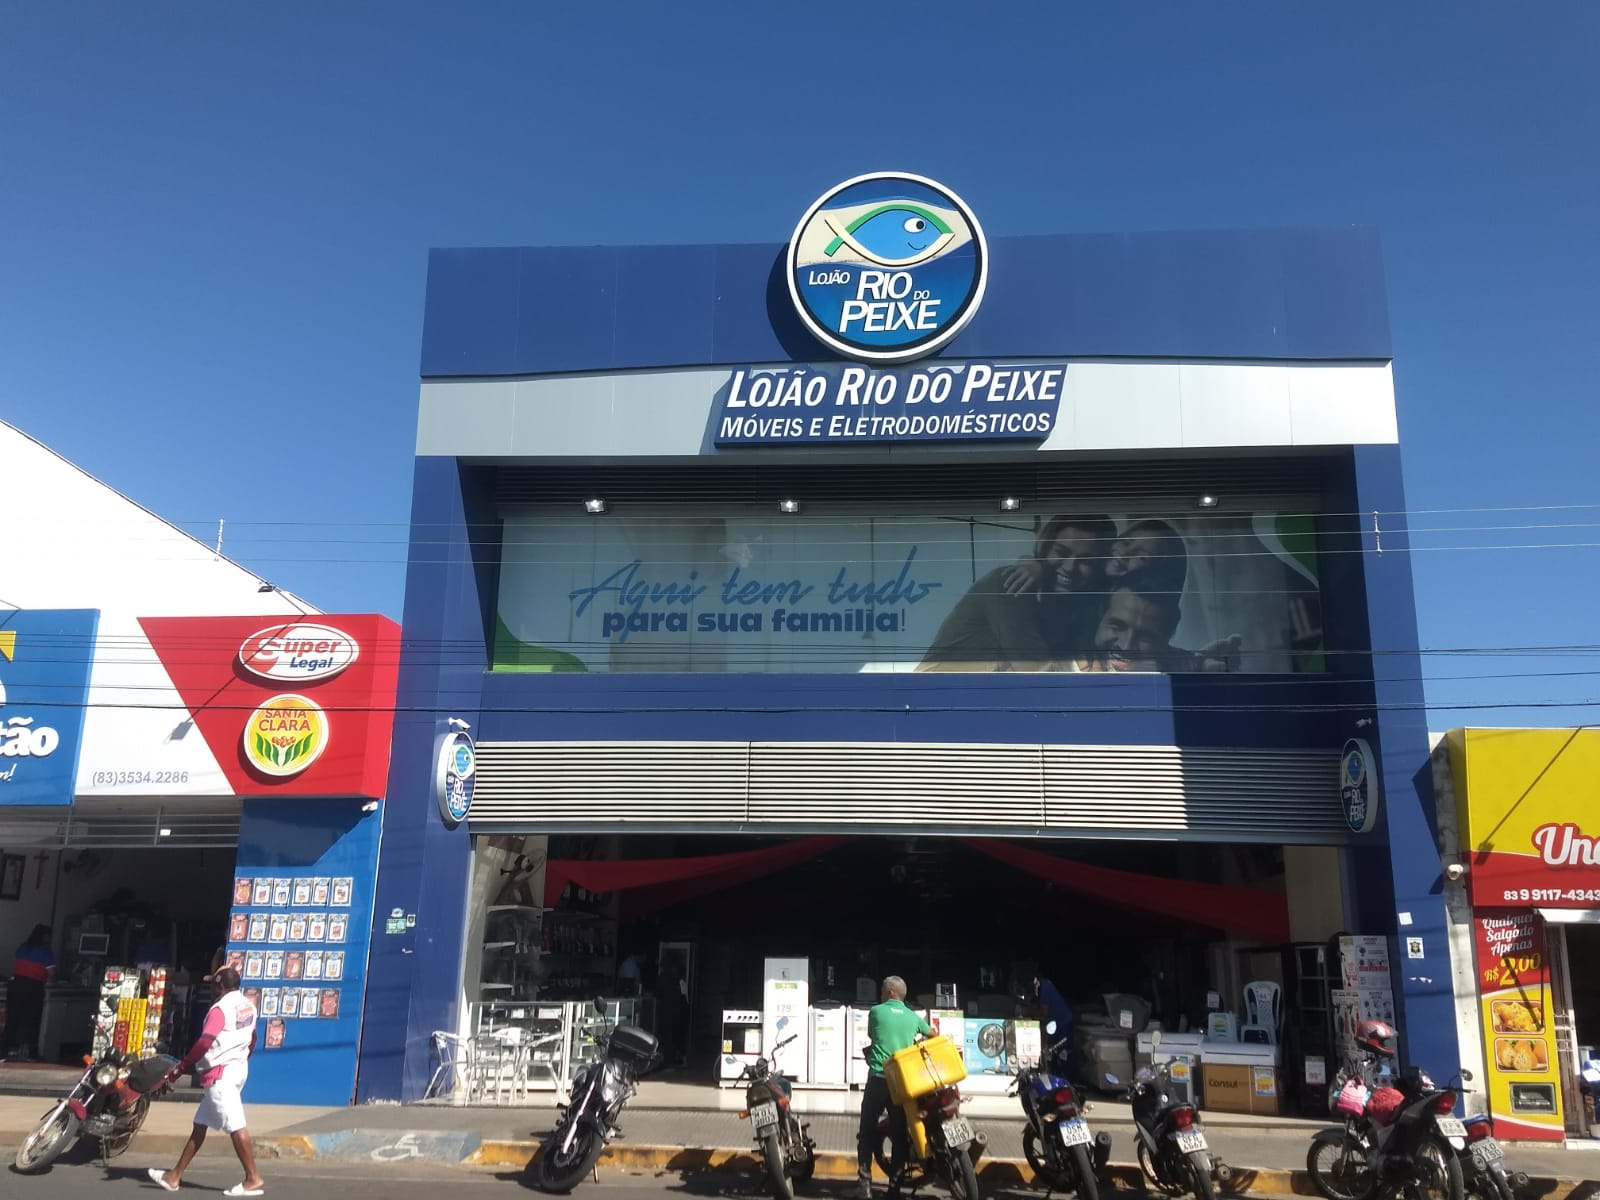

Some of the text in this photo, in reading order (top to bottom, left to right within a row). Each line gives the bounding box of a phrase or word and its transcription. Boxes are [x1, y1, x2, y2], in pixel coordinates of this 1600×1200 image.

[809, 269, 930, 300] LOJÃO RIO DO
[839, 299, 941, 333] PEIXE
[727, 364, 1062, 408] LOJÃO RIO DO PEIXE
[720, 410, 1051, 438] MÓVEIS E ELETRODOMÉSTICOS
[568, 545, 942, 644] Aqui tem tudo
[602, 611, 688, 637] para
[697, 612, 762, 632] sua
[254, 636, 342, 660] Super
[290, 657, 333, 671] Legal
[259, 719, 311, 731] CLARA
[265, 709, 307, 718] SANTA
[92, 771, 189, 787] (83)3534.2286
[1535, 827, 1600, 865] Un
[1504, 890, 1518, 900] 83
[1520, 889, 1529, 900] 9
[1491, 940, 1533, 956] Apenas
[1485, 966, 1499, 982] R$
